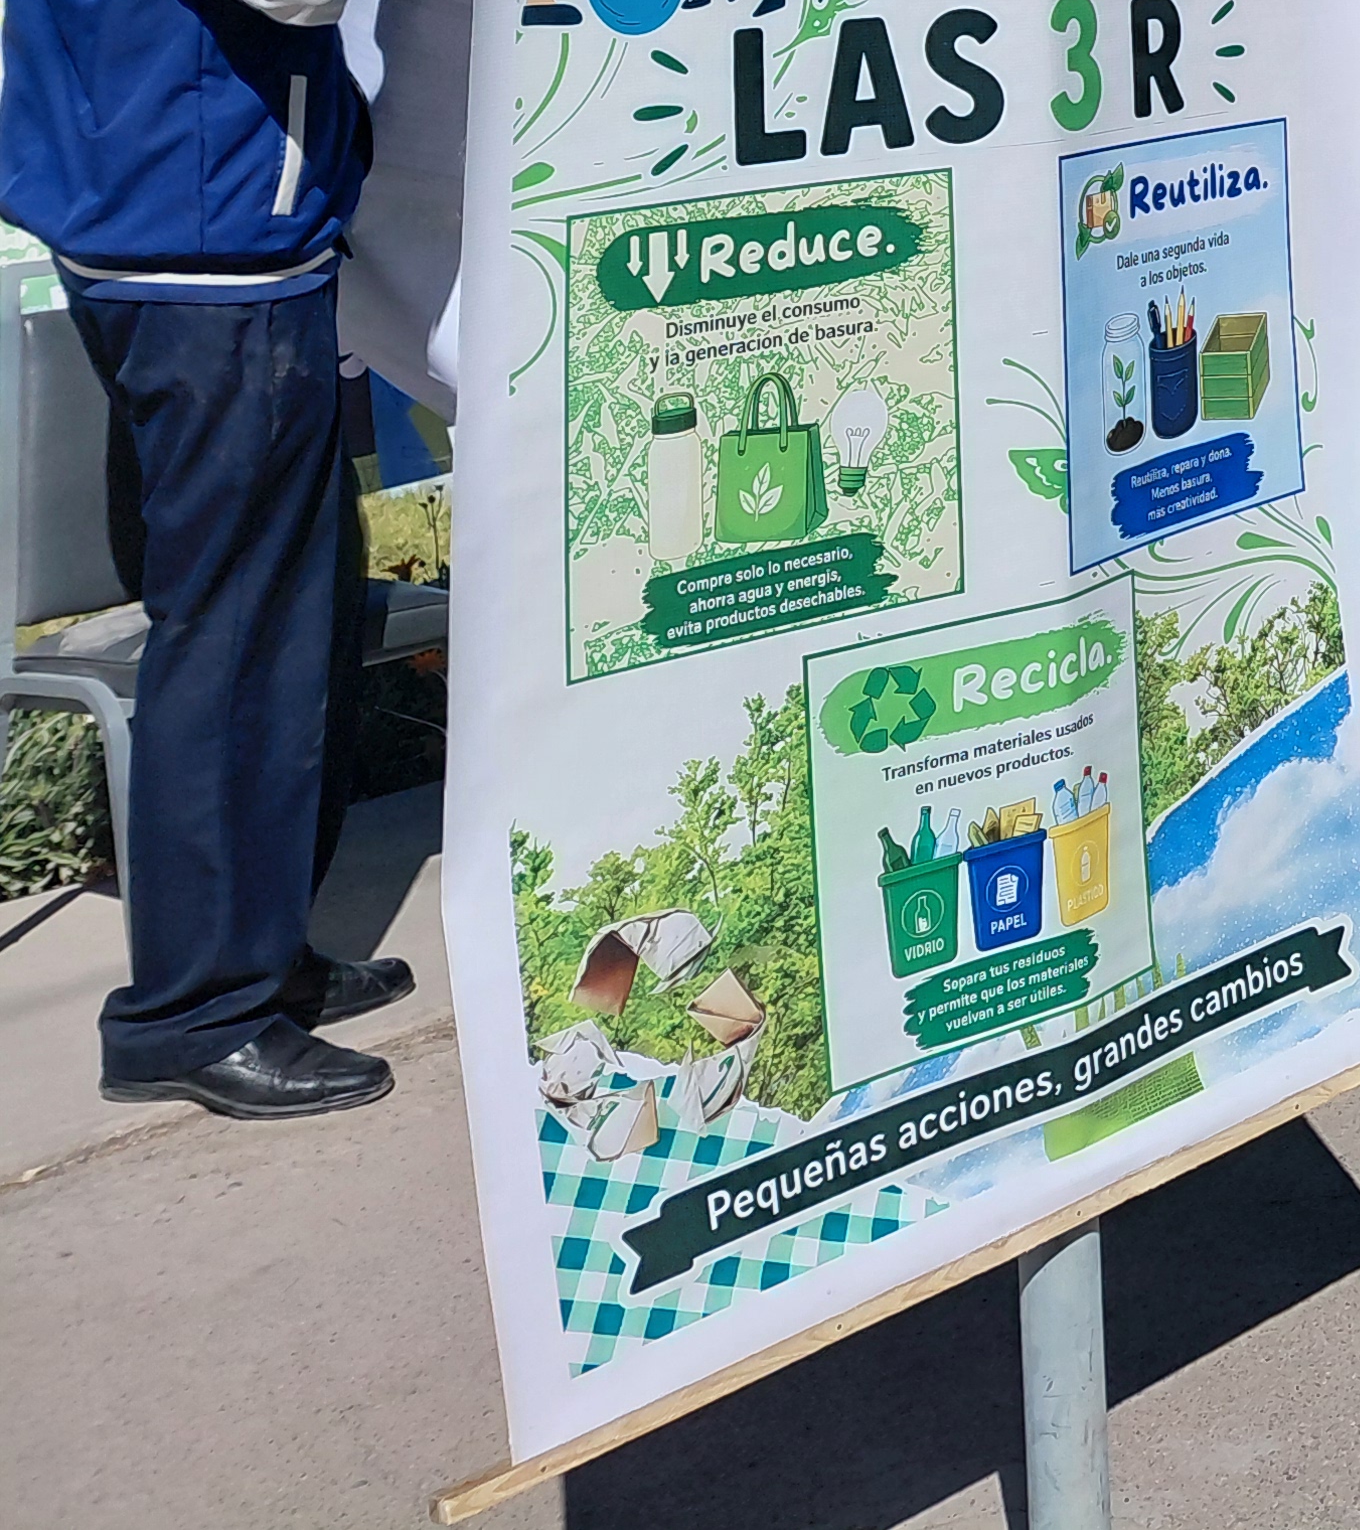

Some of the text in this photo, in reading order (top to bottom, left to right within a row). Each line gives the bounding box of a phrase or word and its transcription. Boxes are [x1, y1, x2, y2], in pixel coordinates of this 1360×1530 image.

[733, 7, 1005, 166] LAS
[1130, 163, 1268, 219] Reutiliza.
[700, 221, 895, 284] Reduce.
[1117, 231, 1230, 270] Dale una segunda vida
[1140, 261, 1207, 287] a los objetos.
[666, 297, 860, 339] Disminuye el consumo
[649, 354, 660, 374] y
[788, 327, 809, 344] de
[735, 564, 765, 583] solo
[768, 560, 781, 576] lo
[784, 546, 853, 572] necesario,
[666, 585, 866, 640] evita productos desechables.
[689, 593, 735, 614] ahorra
[738, 584, 773, 603] agua
[775, 582, 785, 597] y
[953, 636, 1113, 712] Recicla.
[882, 713, 1094, 782] Transforma materiales usados
[915, 745, 1074, 795] en nuevos productos.
[990, 913, 1027, 935] PAPEL
[904, 938, 945, 962] VIDRIO
[989, 963, 1010, 980] tus
[1012, 946, 1066, 971] residuos
[917, 955, 1090, 1025] y permite que los materiales
[996, 1003, 1005, 1015] a
[1007, 996, 1028, 1011] ser
[706, 948, 1305, 1231] Pequeñas acciones, grandes cambios
